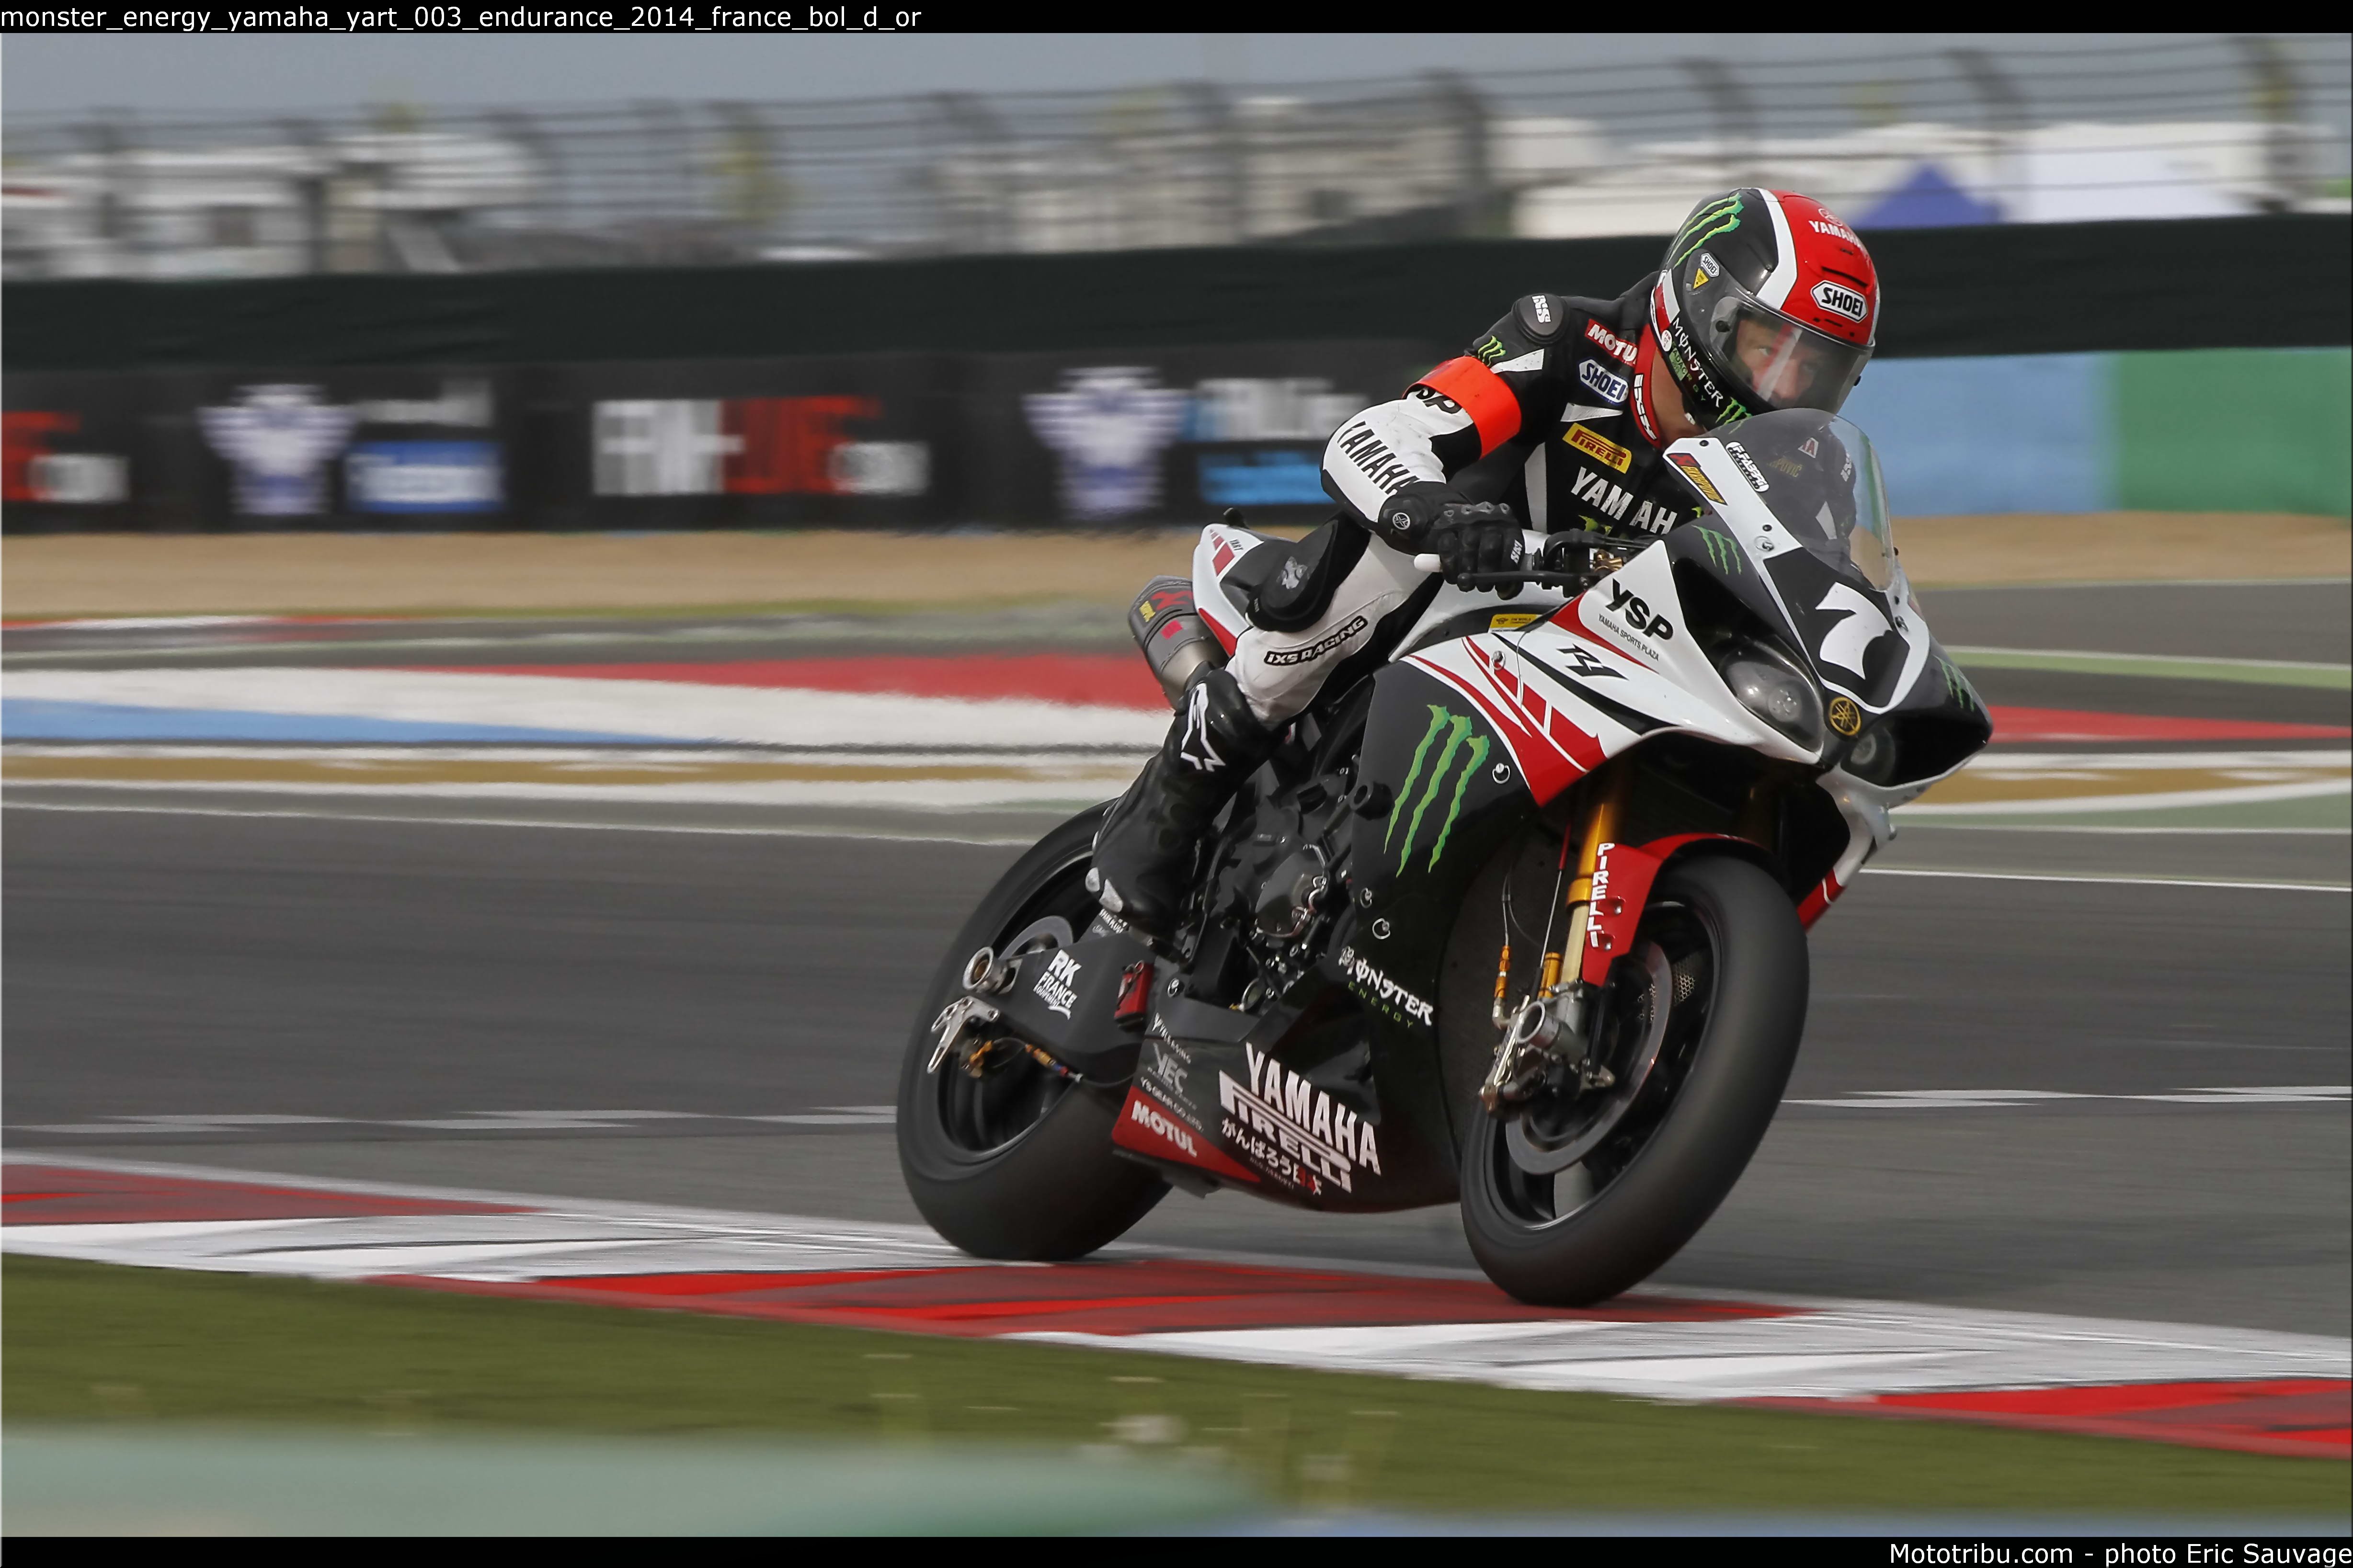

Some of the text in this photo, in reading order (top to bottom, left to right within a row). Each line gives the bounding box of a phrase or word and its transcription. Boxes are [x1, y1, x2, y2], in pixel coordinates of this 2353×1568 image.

[1808, 220, 1862, 249] YAMAH
[1702, 256, 1717, 274] SHOEI
[1821, 287, 1863, 317] SHOEI
[1588, 324, 1637, 364] MOTU
[1672, 317, 1724, 408] MONSTER
[1581, 363, 1626, 400] SHOEI
[1571, 429, 1627, 466] PIRELLI
[1605, 578, 1673, 640] YSP
[1815, 581, 1893, 680] 7
[1301, 618, 1365, 660] RACING
[1598, 614, 1659, 661] YAMAHA SPORTS PLAZA
[1587, 843, 1615, 947] PIRELLI
[1036, 971, 1077, 1009] FRANCE
[1048, 949, 1082, 988] RK
[1153, 1042, 1188, 1094] YEC
[1131, 1100, 1197, 1157] MOTUL
[1219, 1069, 1352, 1193] PIRELLI
[1246, 1042, 1382, 1176] YAMAHA
